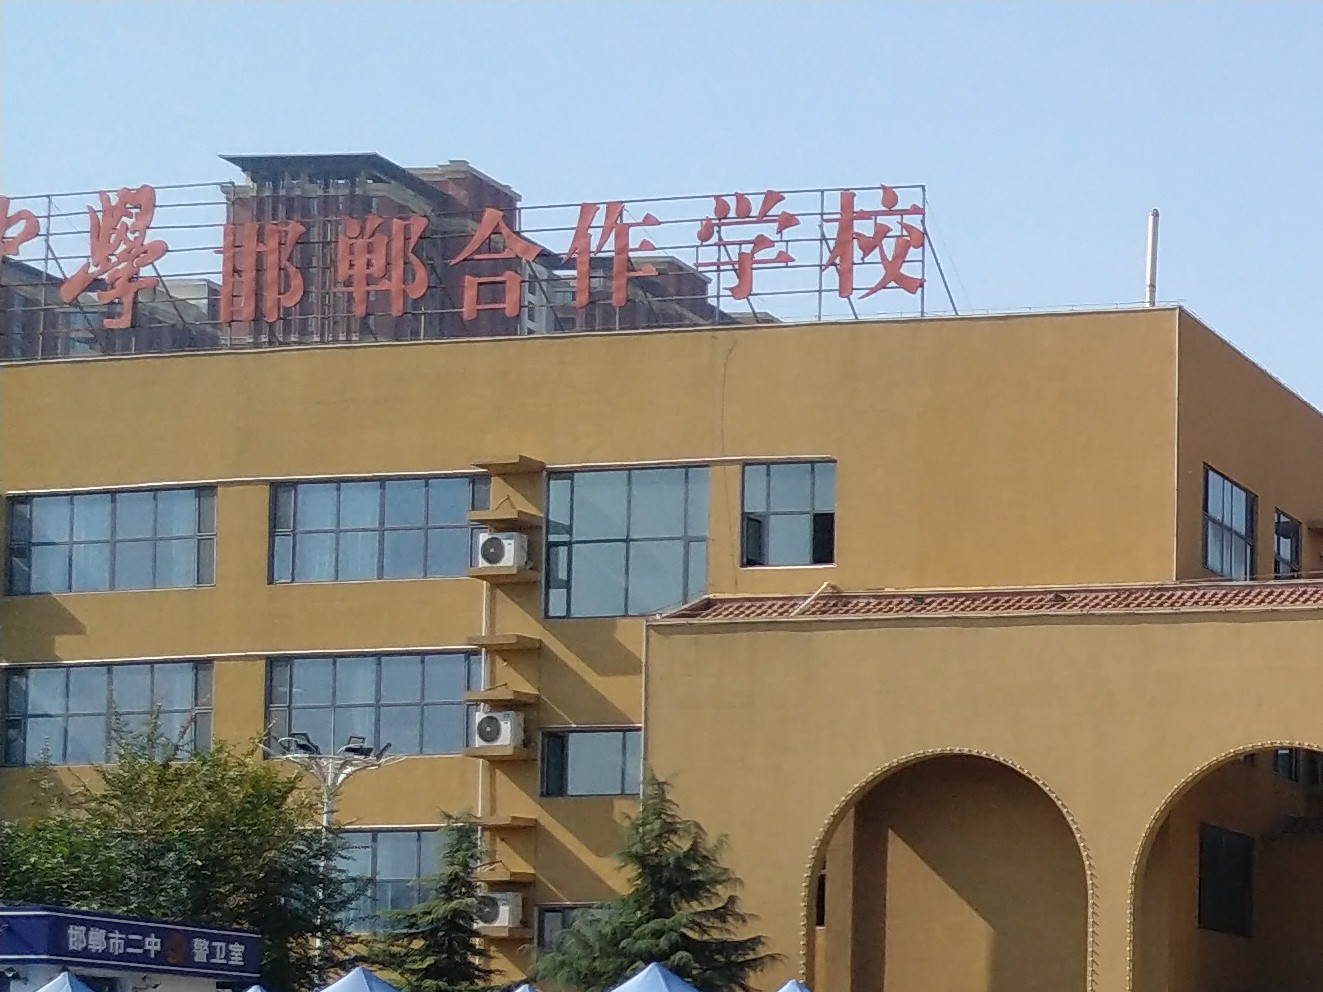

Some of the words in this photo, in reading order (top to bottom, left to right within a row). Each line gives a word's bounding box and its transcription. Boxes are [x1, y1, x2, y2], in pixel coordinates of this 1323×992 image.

[68, 924, 162, 959] 邯郸市二中
[193, 937, 245, 966] 警卫室
